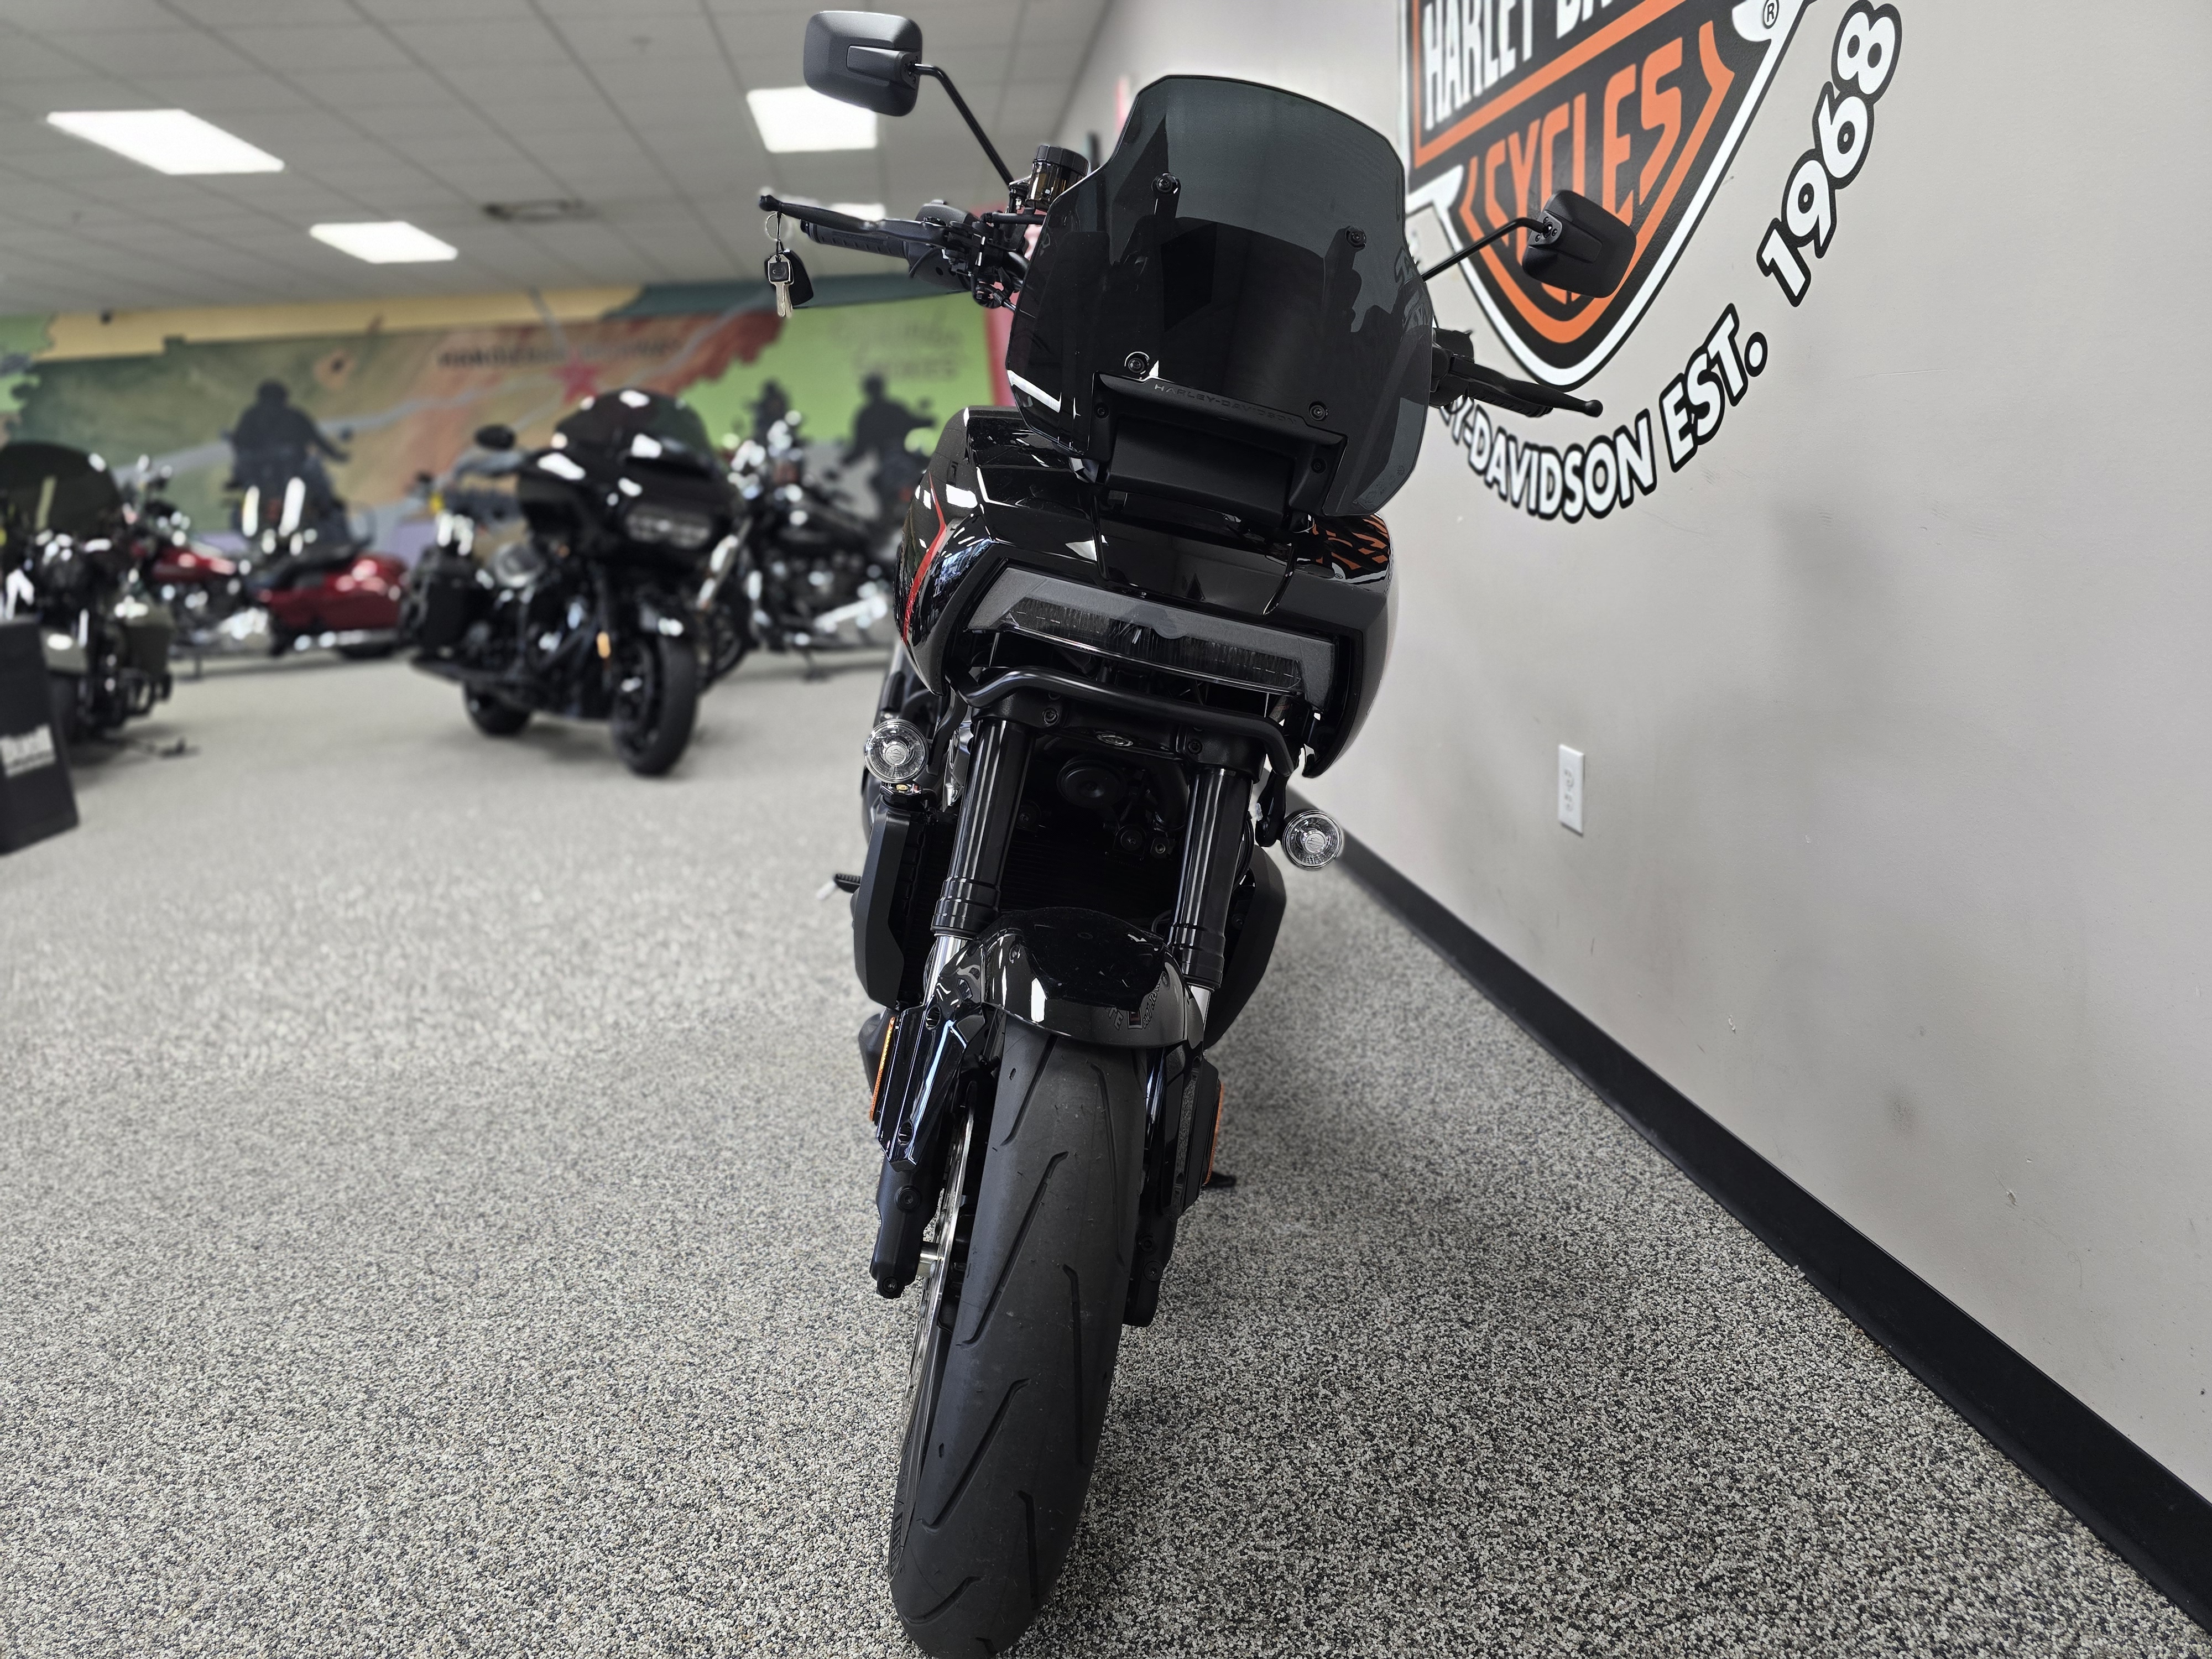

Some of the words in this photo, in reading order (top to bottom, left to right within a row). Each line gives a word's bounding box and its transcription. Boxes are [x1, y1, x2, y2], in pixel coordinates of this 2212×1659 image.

[1439, 395, 1658, 524] Y-DAVIDSON
[1659, 303, 1767, 472] EST.
[1756, 0, 1902, 307] 1968
[1154, 384, 1297, 425] HARLEY-DAVIDSON
